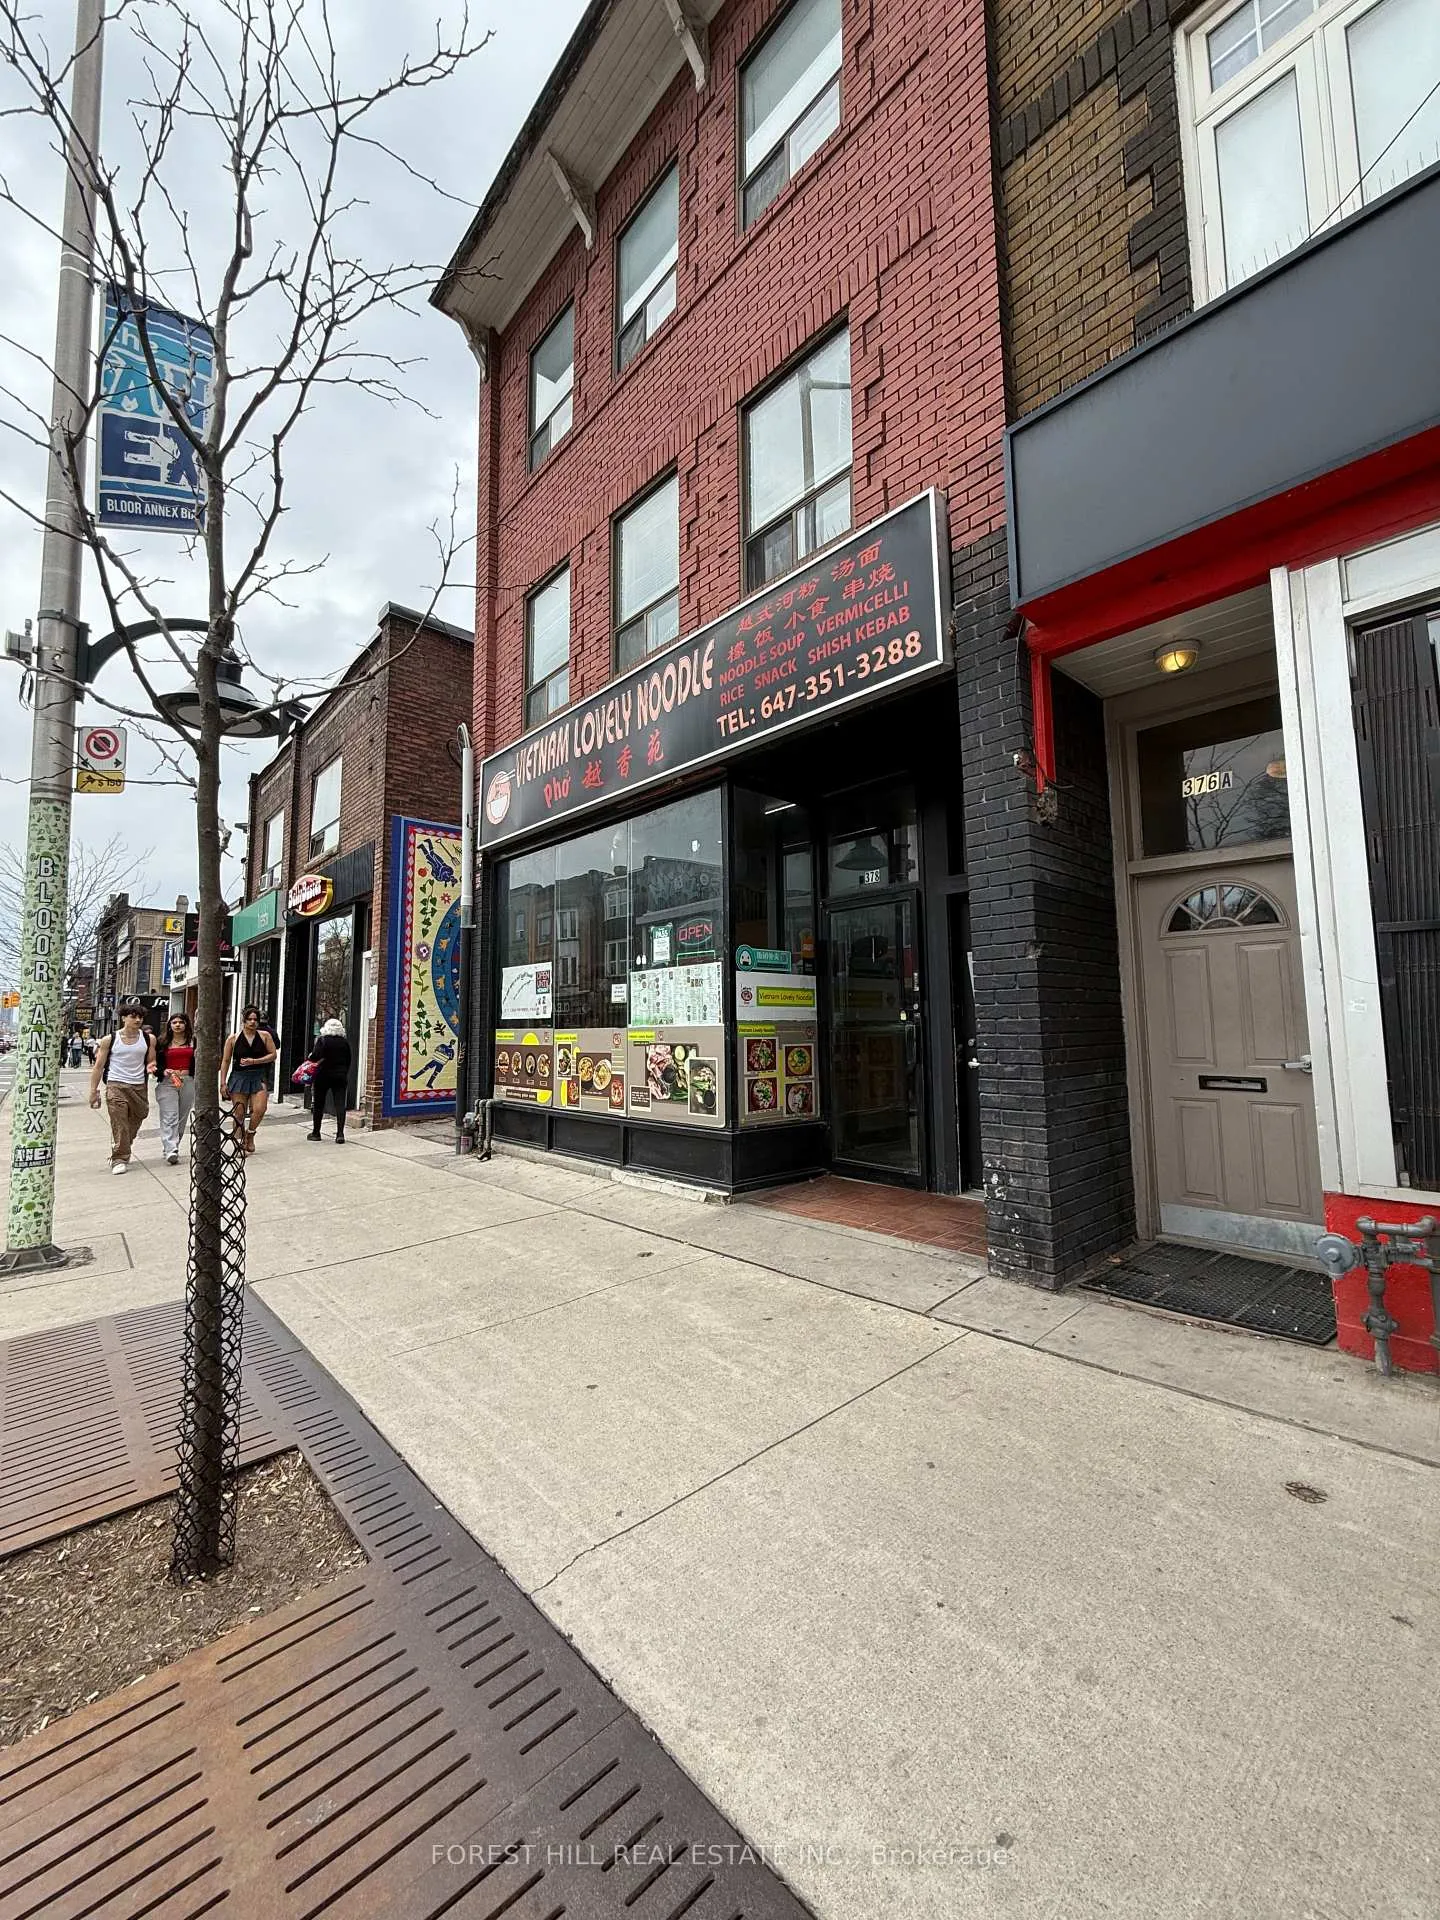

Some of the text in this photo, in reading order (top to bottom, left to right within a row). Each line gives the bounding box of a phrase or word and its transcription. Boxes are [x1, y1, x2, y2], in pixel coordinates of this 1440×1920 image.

[106, 498, 142, 514] BLOOR
[144, 503, 179, 519] ANNEX
[716, 630, 922, 737] TEL: 647-351-3288
[719, 580, 910, 686] NOODLE SOUP VERMICELLI
[720, 605, 911, 707] RICE SNACK SHISH KEBAB
[516, 638, 715, 788] VIETNAM LOVELY NOODLE
[1184, 773, 1231, 795] 376A
[34, 856, 55, 982] BLOOR
[865, 870, 880, 883] 378
[678, 922, 712, 942] OPEN
[26, 1004, 47, 1133] ANNEX
